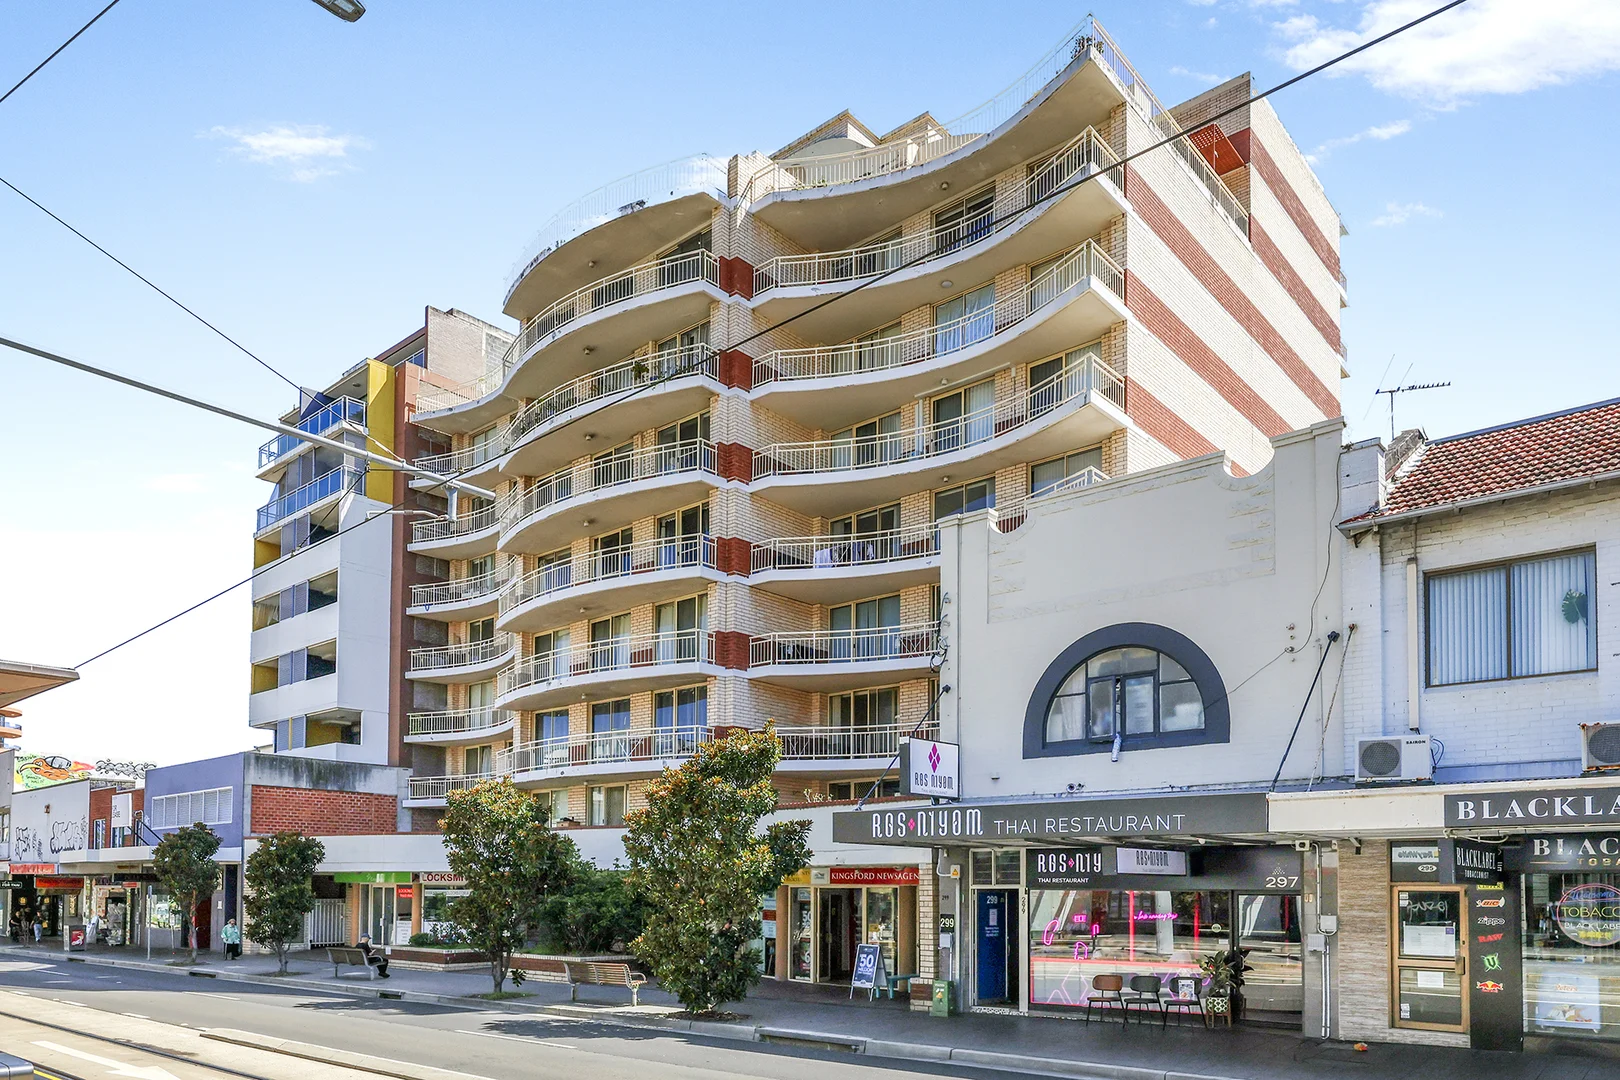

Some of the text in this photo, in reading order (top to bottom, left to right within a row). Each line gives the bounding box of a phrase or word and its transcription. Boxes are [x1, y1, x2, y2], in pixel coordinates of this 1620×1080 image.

[993, 814, 1186, 835] THAI RESTAURANT
[1533, 837, 1619, 856] BLAC
[1456, 847, 1496, 870] BLACKLABEL
[831, 872, 875, 880] KINGSFORD
[1265, 876, 1299, 888] 297
[986, 895, 998, 904] 299
[940, 918, 954, 928] 299
[1477, 933, 1504, 943] RAW
